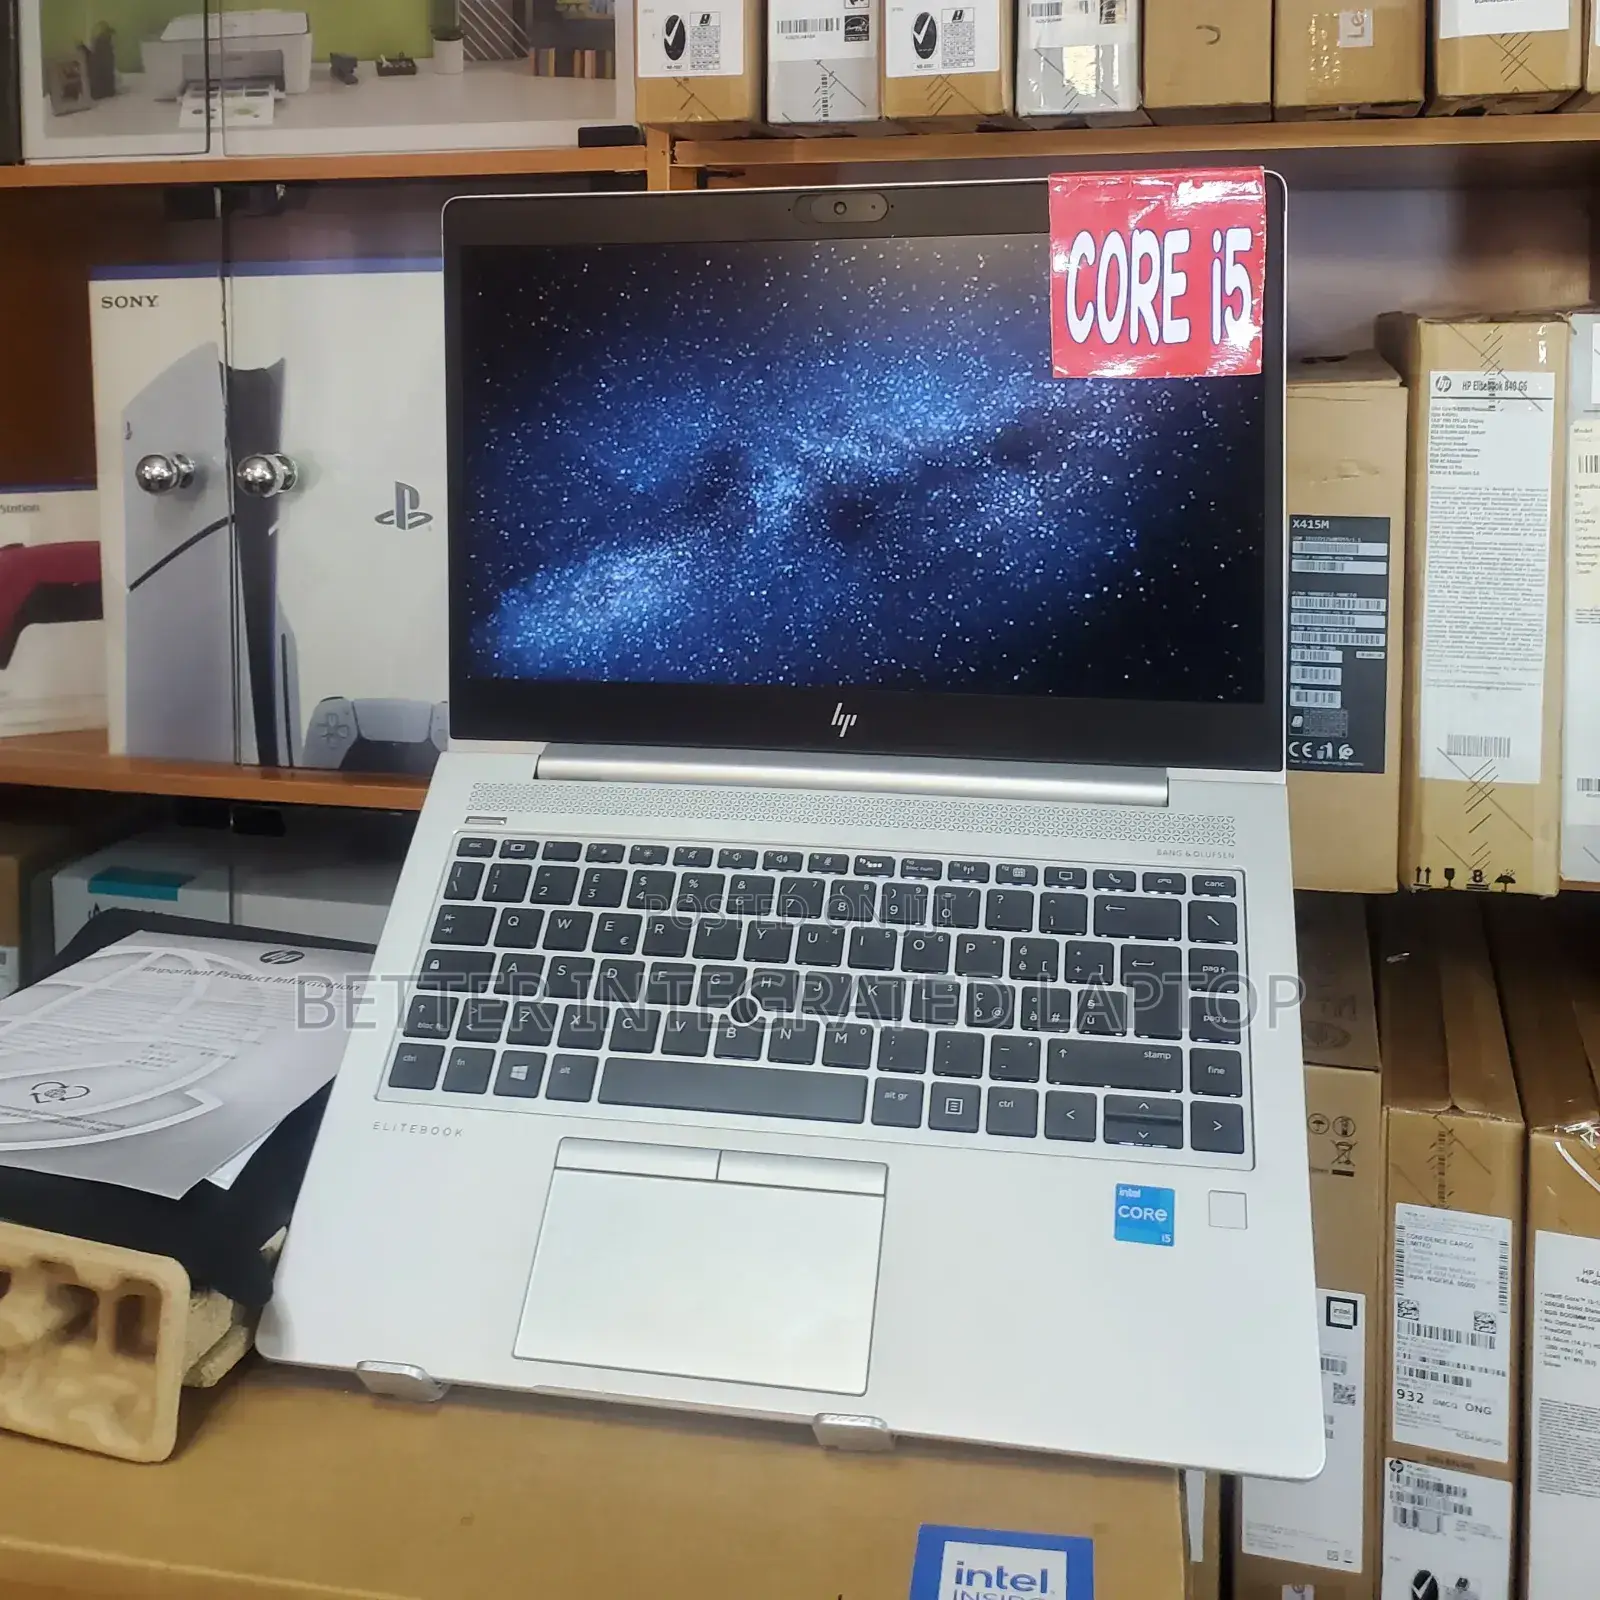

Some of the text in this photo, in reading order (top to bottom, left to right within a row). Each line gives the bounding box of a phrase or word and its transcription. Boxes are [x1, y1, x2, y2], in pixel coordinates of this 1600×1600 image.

[1066, 228, 1253, 346] CORE i5
[100, 295, 159, 308] SONY
[1292, 519, 1330, 530] X415M
[831, 702, 858, 738] hp
[1156, 848, 1183, 857] BANG
[1193, 850, 1235, 859] OLUFSEN
[639, 875, 648, 886] $
[688, 878, 700, 889] %
[737, 880, 746, 890] &
[538, 886, 549, 896] 2
[588, 888, 597, 898] 3
[636, 890, 646, 900] 4
[686, 893, 695, 904] 5
[735, 896, 744, 906] 6
[787, 898, 796, 908] 7
[996, 894, 1004, 905] ?
[837, 901, 847, 912] 8
[889, 904, 898, 915] 9
[507, 915, 519, 927] Q
[558, 918, 572, 929] W
[604, 920, 615, 931] E
[654, 923, 664, 934] R
[704, 926, 714, 937] T
[757, 928, 767, 940] Y
[619, 935, 630, 946] €
[807, 932, 818, 943] U
[965, 942, 976, 954] P
[1019, 945, 1028, 956] é
[507, 962, 518, 973] A
[556, 964, 567, 976] S
[1019, 960, 1027, 971] è
[1202, 965, 1219, 973] pag
[142, 966, 361, 992] Important Product Information
[606, 968, 618, 979] D
[656, 970, 667, 981] F
[710, 974, 721, 985] G
[760, 976, 772, 988] H
[813, 981, 822, 992] J
[867, 984, 879, 996] K
[922, 988, 930, 1000] L
[518, 1011, 531, 1023] Z
[569, 1014, 581, 1026] X
[1051, 1012, 1061, 1023] #
[622, 1018, 633, 1029] C
[675, 1021, 687, 1033] V
[725, 1027, 737, 1039] B
[780, 1028, 792, 1040] N
[835, 1032, 848, 1044] M
[402, 1054, 417, 1062] ctrl
[1143, 1050, 1172, 1062] stamp
[456, 1058, 466, 1066] fn
[559, 1065, 571, 1075] alt
[1206, 1065, 1226, 1075] fine
[884, 1091, 908, 1101] alt gr
[998, 1099, 1014, 1108] ctrl
[372, 1121, 464, 1139] ELITEBOOK
[1119, 1186, 1141, 1198] intel
[1161, 1233, 1171, 1243] i5
[1396, 1388, 1425, 1404] 932
[1464, 1402, 1493, 1415] ONG
[954, 1560, 1049, 1594] intel
